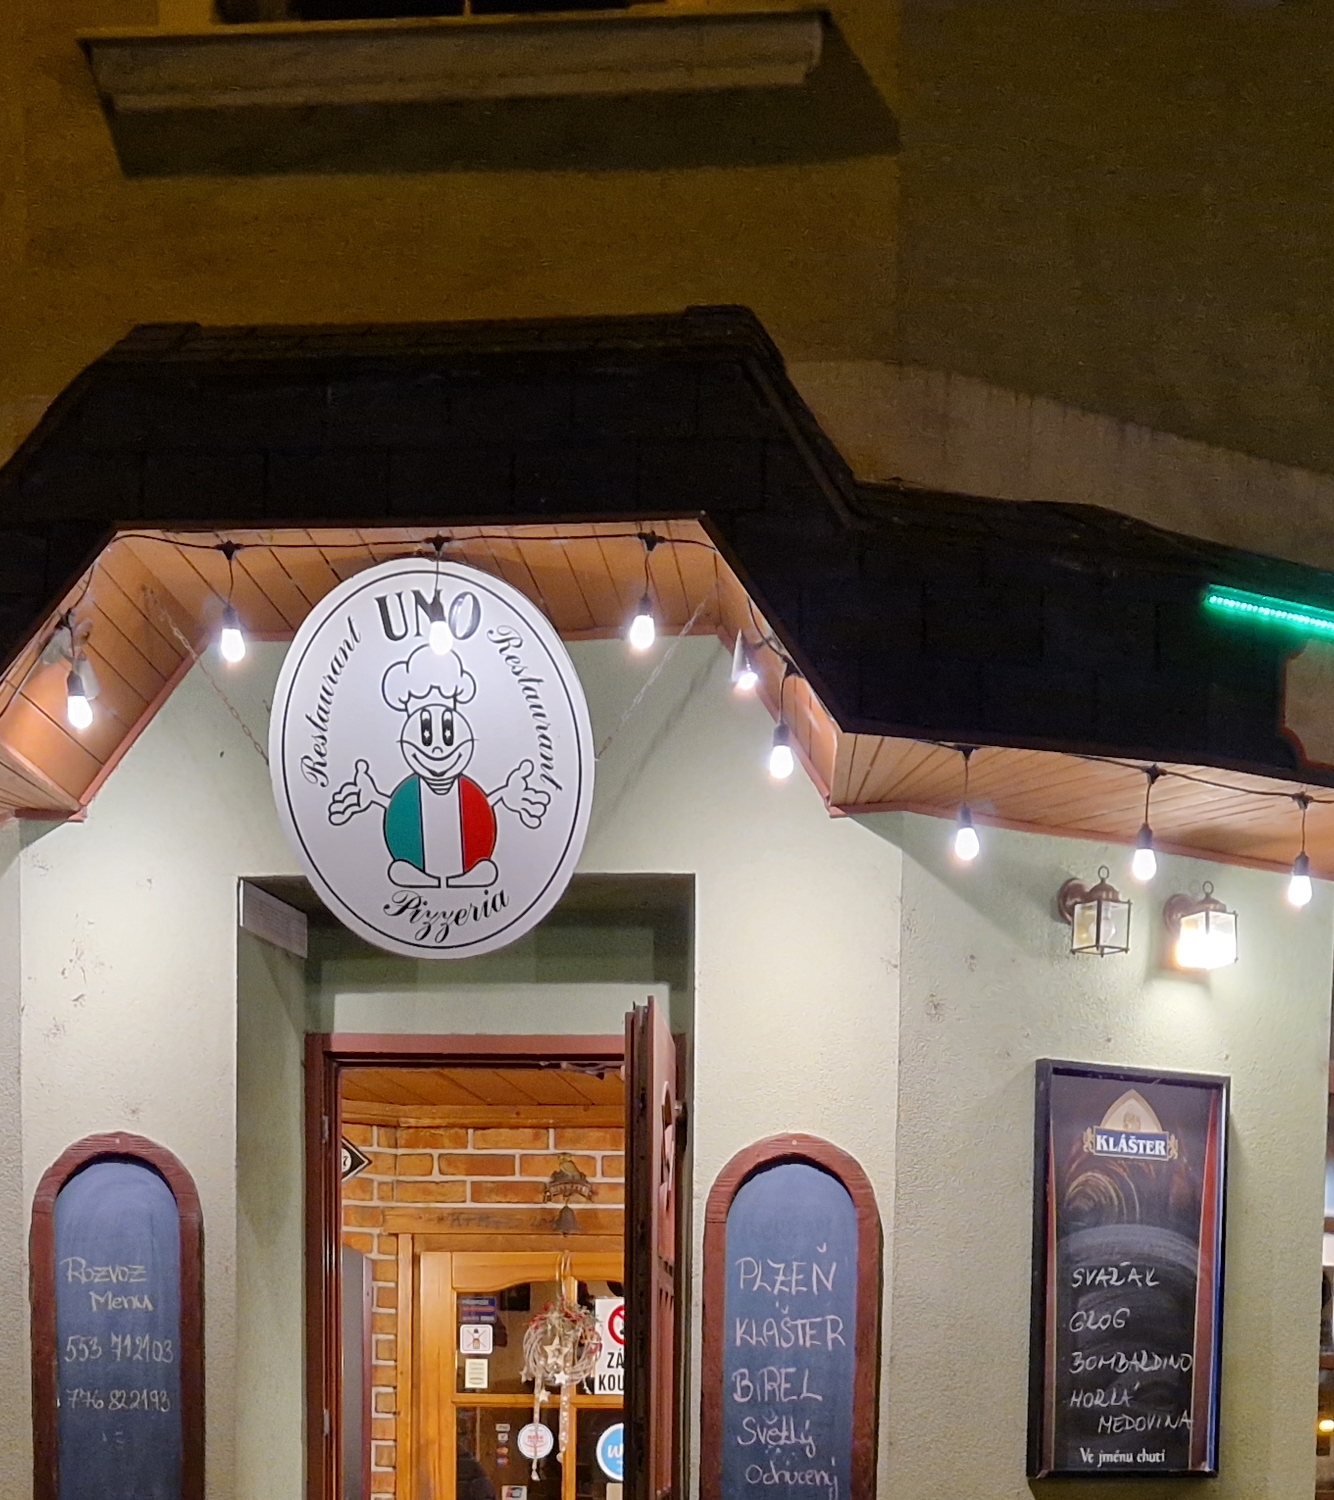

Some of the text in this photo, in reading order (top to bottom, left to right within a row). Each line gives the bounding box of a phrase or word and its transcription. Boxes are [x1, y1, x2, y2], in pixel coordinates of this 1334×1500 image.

[374, 589, 481, 641] UNO
[299, 615, 361, 788] Restaurant
[487, 624, 563, 792] Restaurant
[383, 889, 510, 943] Pizzeria
[1096, 1133, 1167, 1156] KLÁŠTER
[735, 1242, 838, 1296] PLZEŇ
[89, 1291, 154, 1312] Menu
[64, 1334, 102, 1362] 553
[1069, 1350, 1193, 1374] BOMBARDINO
[66, 1387, 104, 1409] 776
[732, 1366, 823, 1403] BIREL
[737, 1415, 816, 1458] Světlý
[1098, 1410, 1194, 1434] MEDOVINA
[1080, 1447, 1095, 1463] Ve
[1097, 1449, 1134, 1468] jménu
